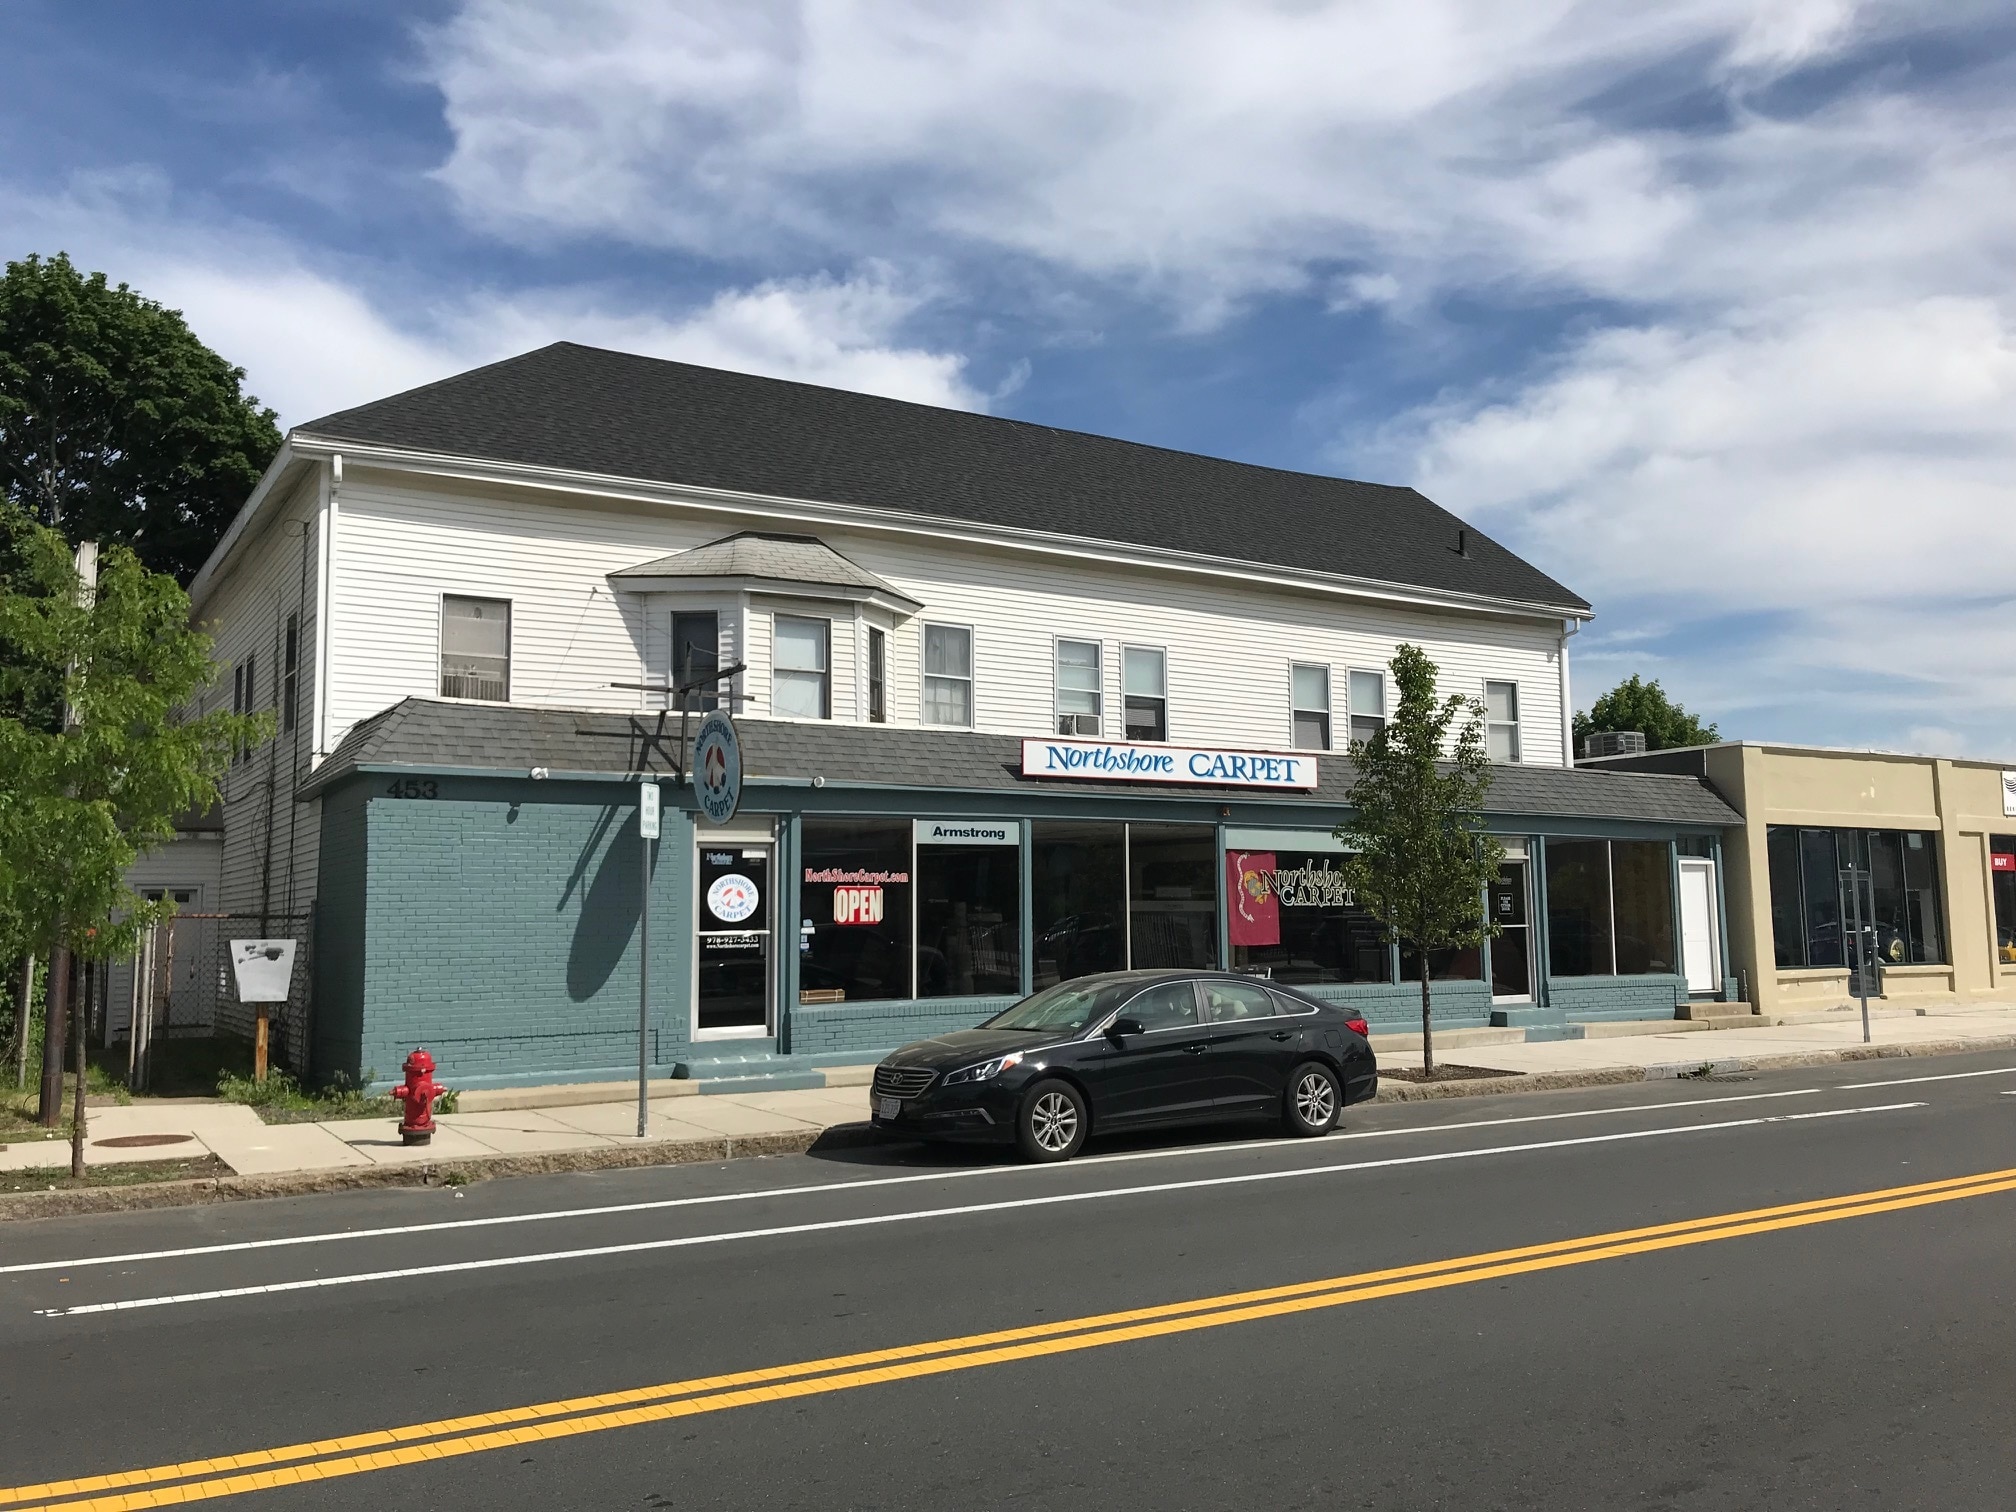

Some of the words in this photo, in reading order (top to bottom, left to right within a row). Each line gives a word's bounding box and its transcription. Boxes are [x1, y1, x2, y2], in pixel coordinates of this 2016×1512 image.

[696, 719, 732, 755] NORTHSHORE
[1045, 746, 1174, 773] Northshore
[1188, 753, 1300, 782] CARPET
[386, 778, 439, 799] 453
[704, 787, 734, 817] CARPET
[932, 826, 1006, 840] Armstrong
[1994, 857, 2007, 867] BUY
[712, 877, 754, 896] NORTHSHORE
[804, 868, 909, 885] NorthShoreCarpet.com
[1261, 858, 1346, 896] Northsho
[836, 889, 882, 923] OPEN
[1279, 885, 1356, 908] CARPET
[714, 905, 752, 919] CARPET
